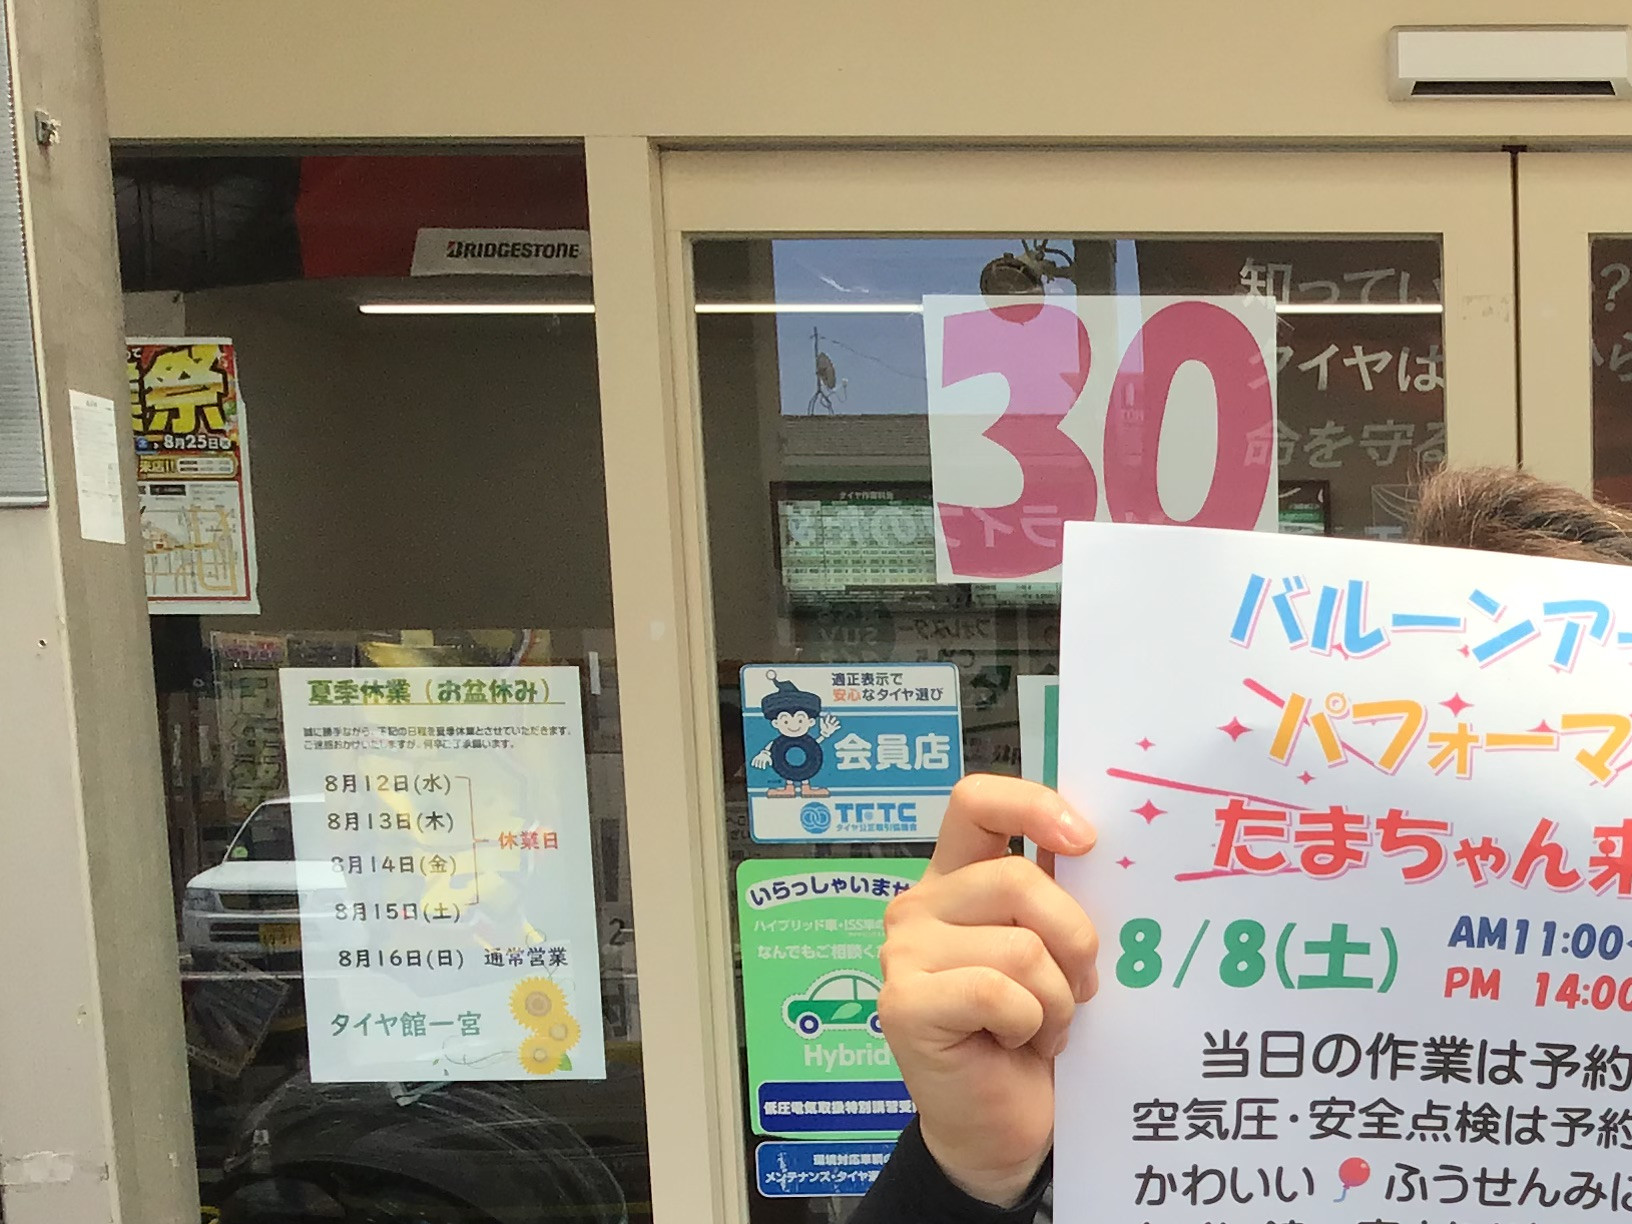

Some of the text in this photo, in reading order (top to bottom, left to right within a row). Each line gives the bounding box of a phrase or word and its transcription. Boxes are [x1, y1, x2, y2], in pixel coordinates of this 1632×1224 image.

[446, 241, 579, 258] BRIDGESTONE
[937, 300, 1273, 579] 30
[831, 672, 904, 687] 適正表示で
[833, 688, 943, 701] 安心なタイヤ選び
[834, 733, 951, 771] 会員店
[324, 773, 451, 794] 8月12日(水)
[327, 812, 454, 833] 8月13日(木)
[498, 830, 559, 850] 休業日
[330, 854, 458, 876] 8月14日(金)
[334, 902, 461, 923] 8月15日(土)
[338, 947, 568, 970] 8月16日(日) 通常営業
[1444, 966, 1501, 1000] PM
[331, 1011, 481, 1038] タイヤ館一宮
[804, 1044, 893, 1072] Hybrid
[1134, 1163, 1315, 1206] かわいい
